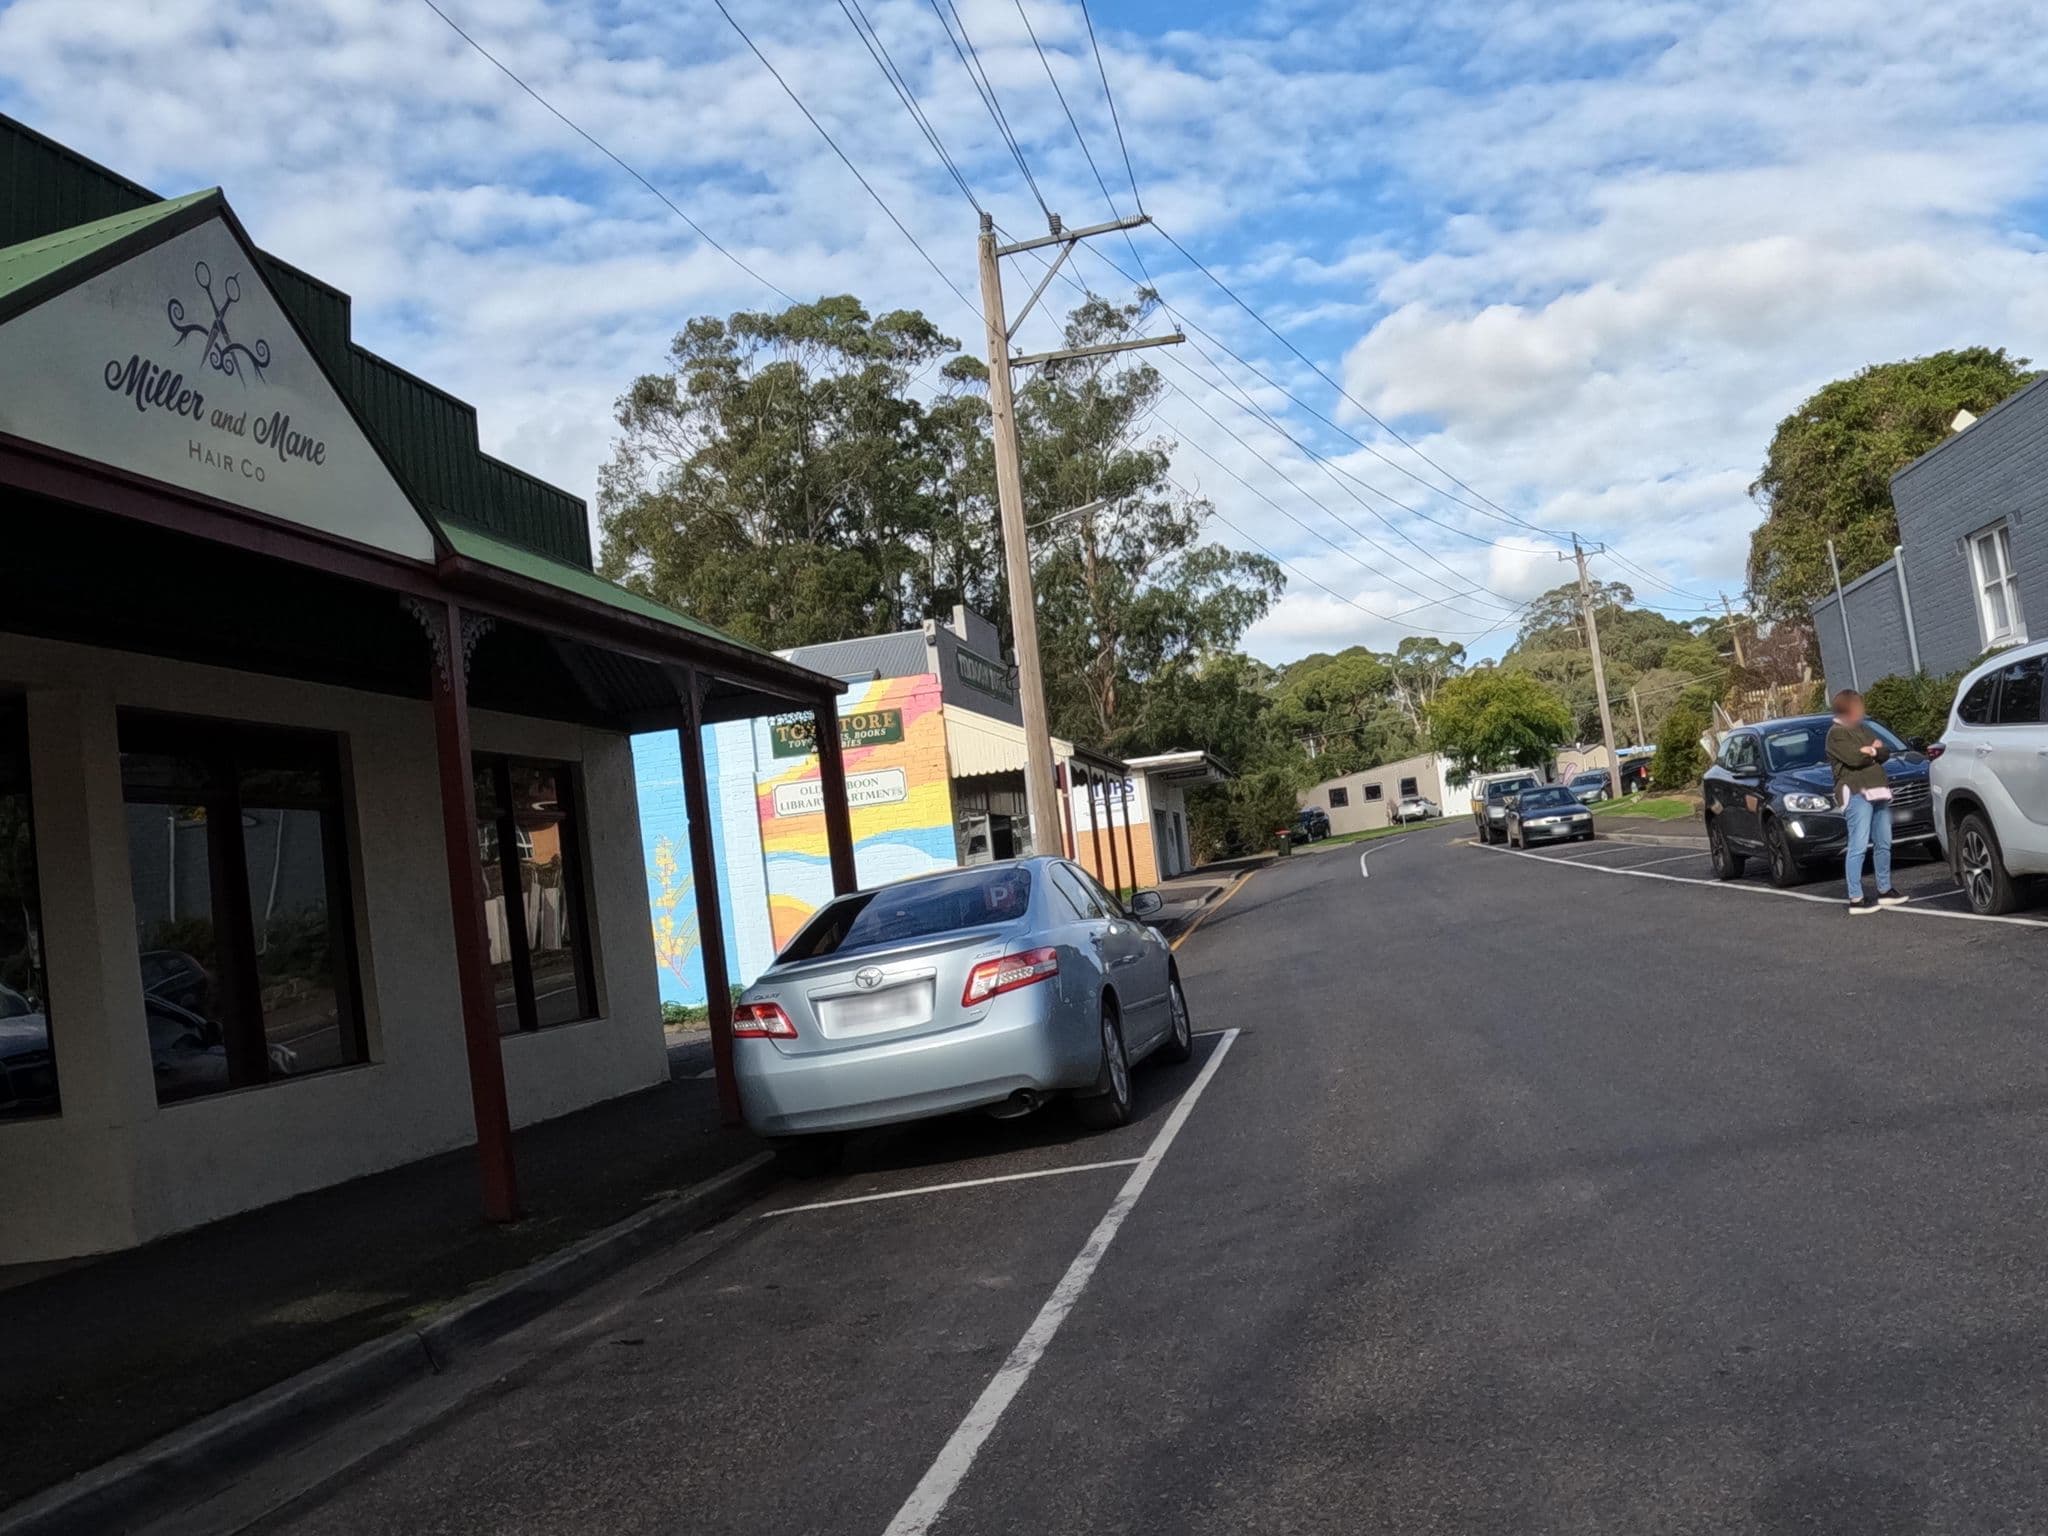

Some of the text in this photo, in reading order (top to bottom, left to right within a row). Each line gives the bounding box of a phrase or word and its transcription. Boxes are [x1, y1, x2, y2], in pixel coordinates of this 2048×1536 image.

[104, 354, 326, 466] Miller and Mane
[188, 439, 234, 473] HAIR
[839, 711, 896, 732] TORE
[854, 728, 887, 739] BOOKS
[990, 886, 1008, 907] P
